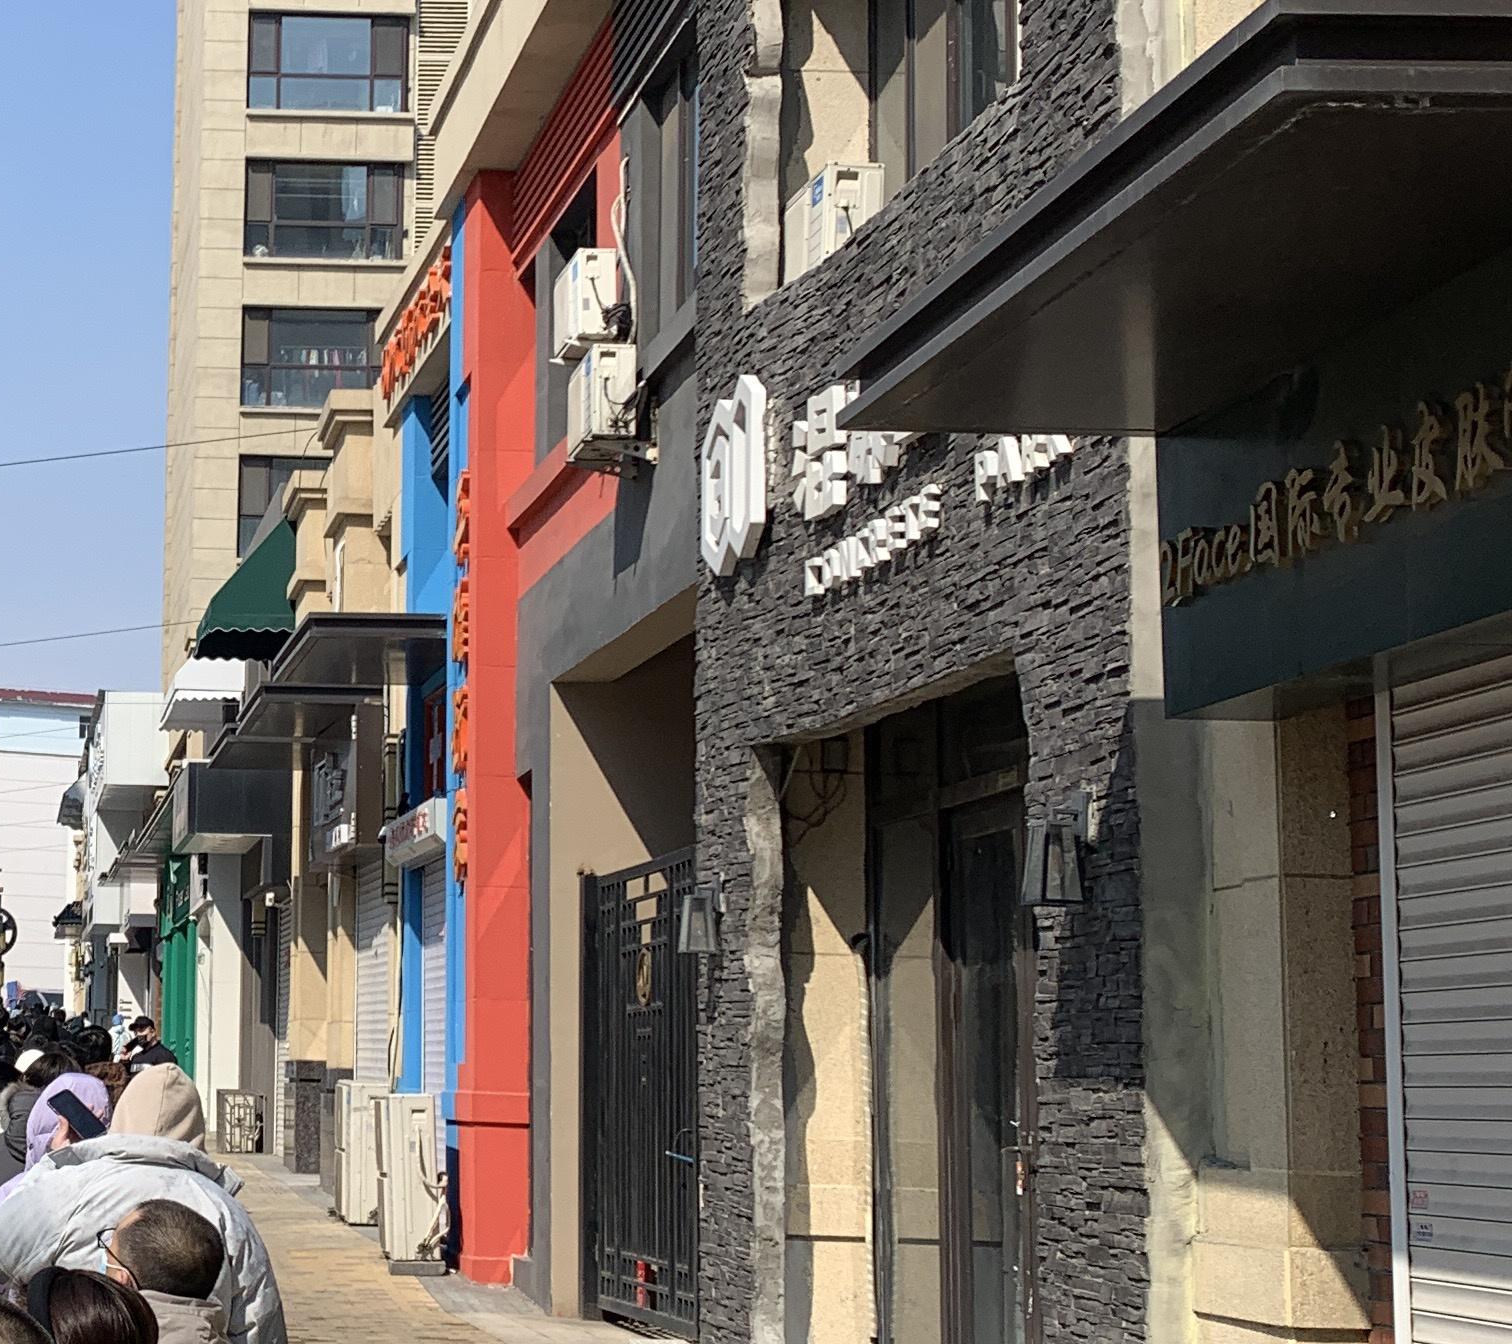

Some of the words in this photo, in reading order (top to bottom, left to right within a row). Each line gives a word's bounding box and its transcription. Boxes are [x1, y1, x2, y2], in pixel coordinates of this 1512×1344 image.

[1250, 367, 1512, 568] 国际专业皮肤
